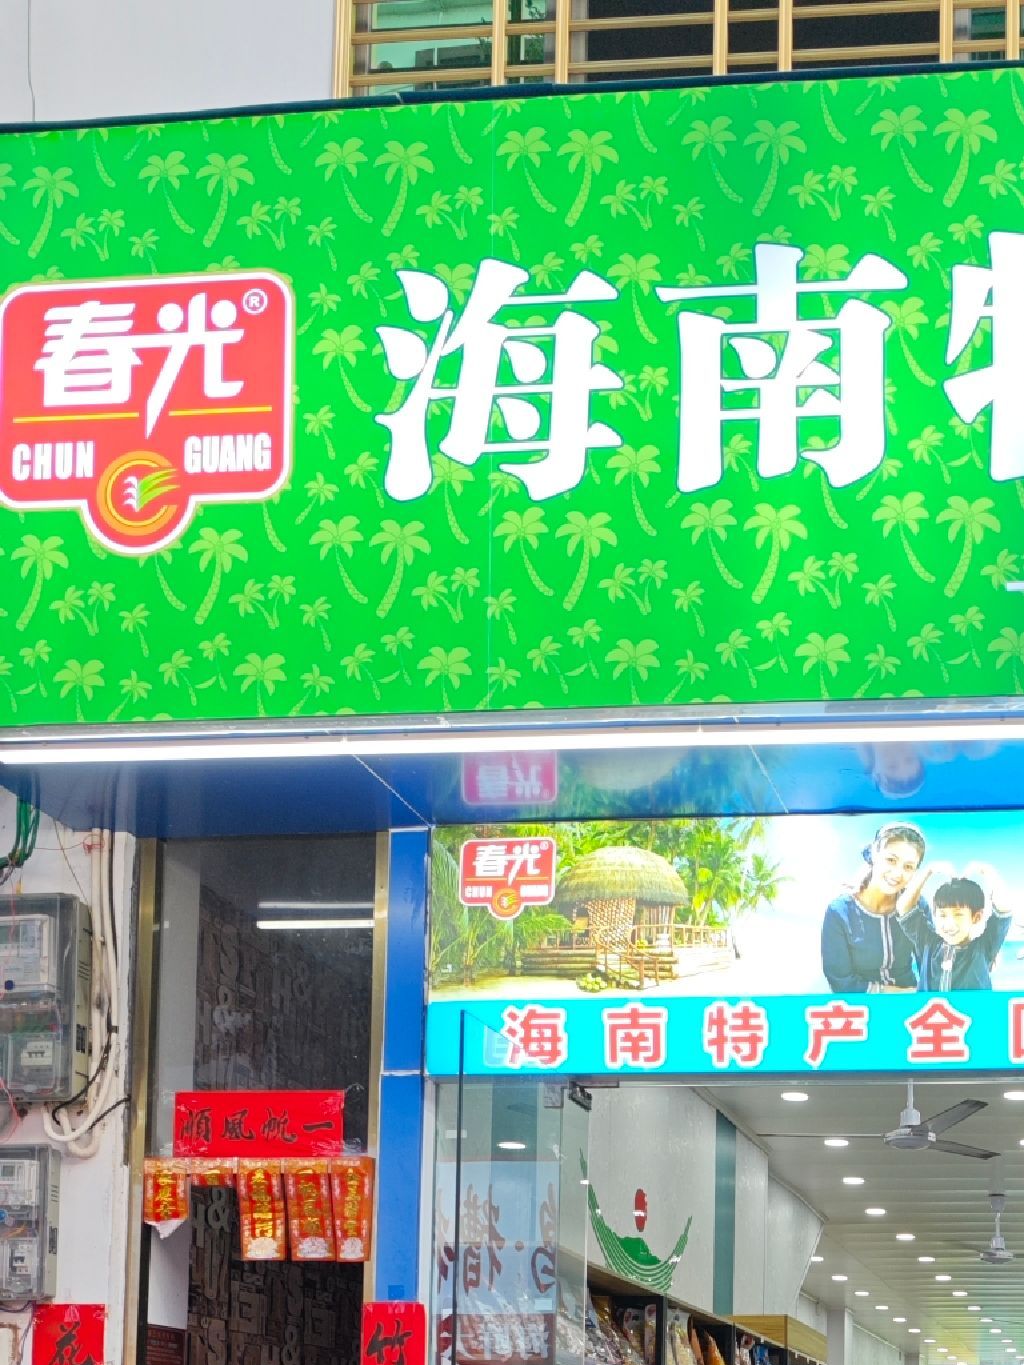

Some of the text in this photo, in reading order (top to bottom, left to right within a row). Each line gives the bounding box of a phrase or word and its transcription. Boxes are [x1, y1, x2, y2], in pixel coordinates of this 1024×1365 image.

[35, 293, 246, 438] 春光
[13, 432, 272, 481] CHUN GUANG
[473, 844, 541, 886] 春光
